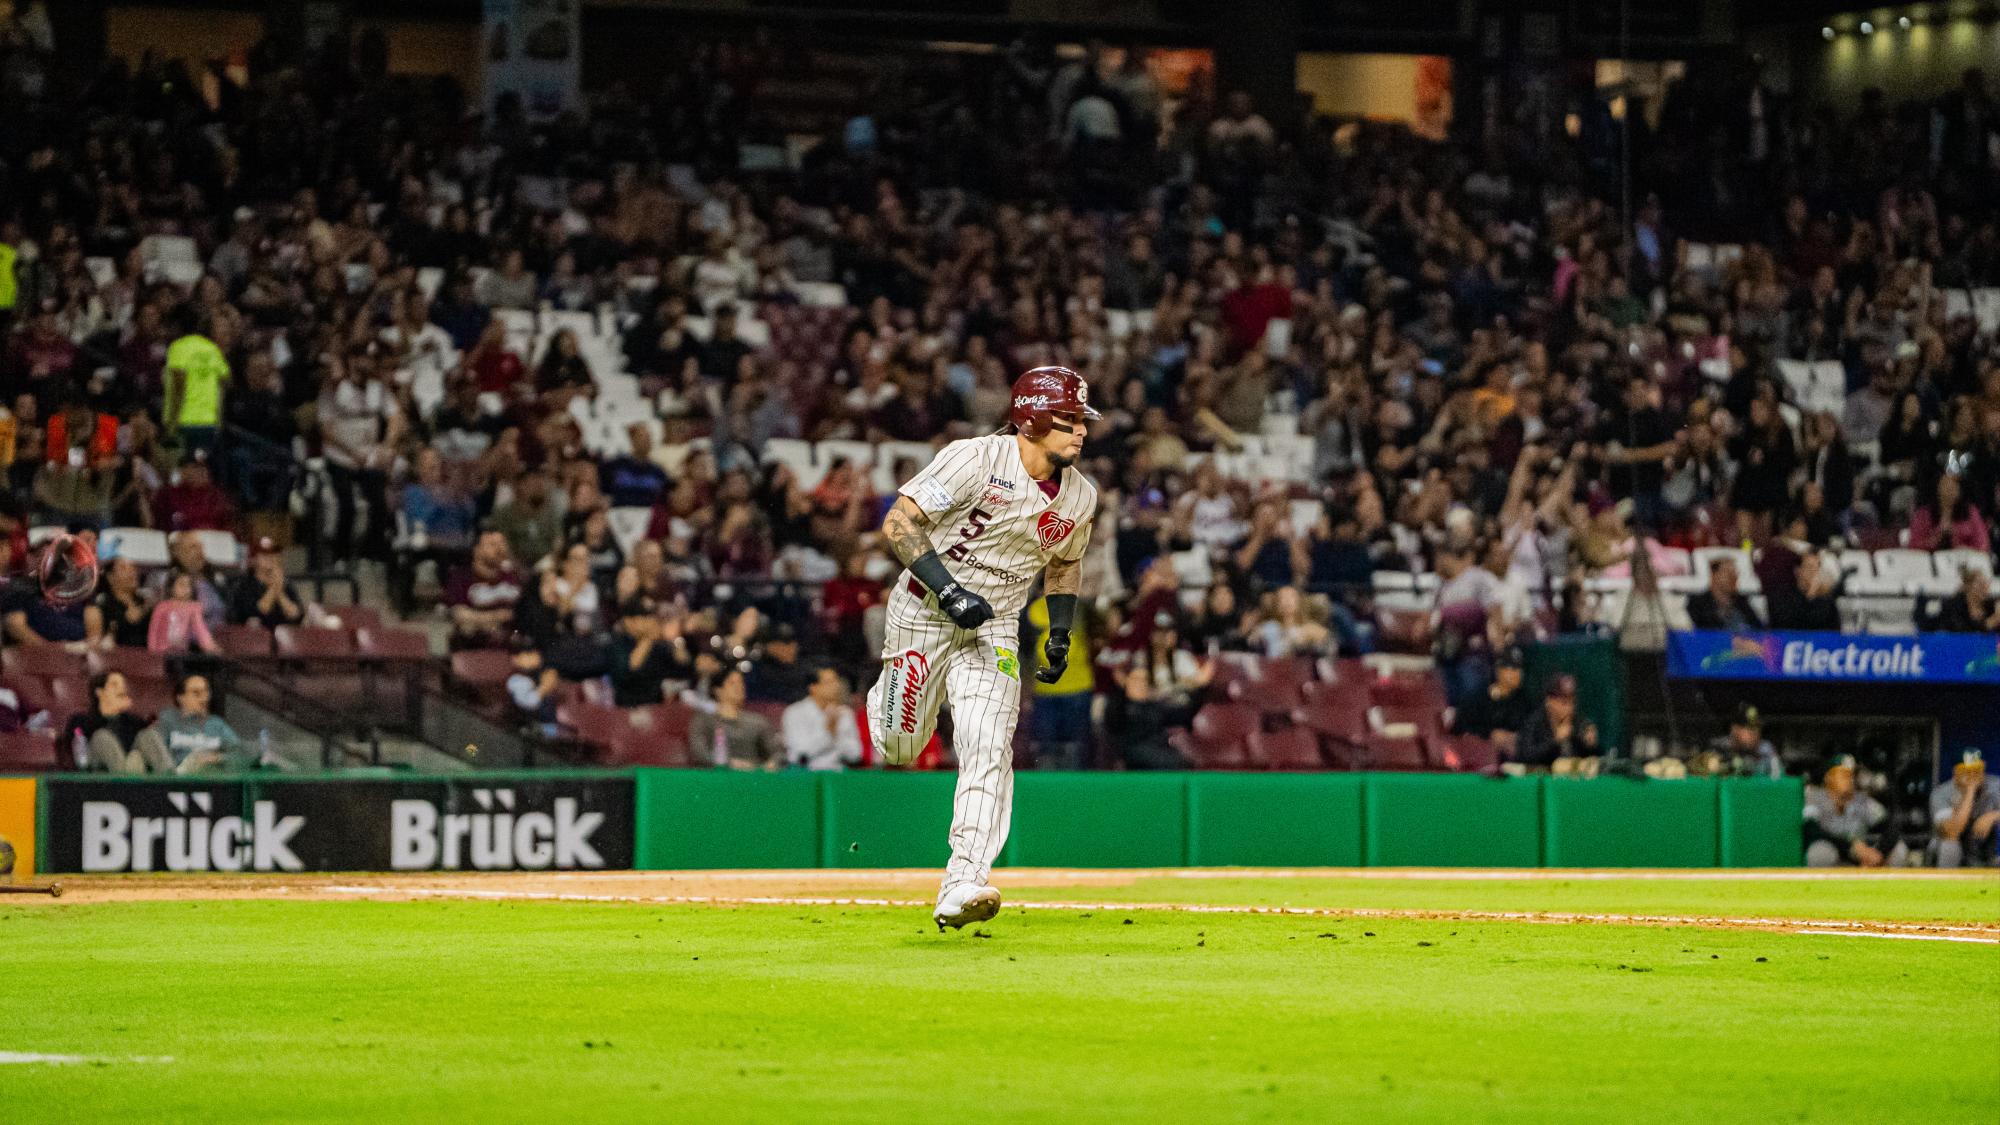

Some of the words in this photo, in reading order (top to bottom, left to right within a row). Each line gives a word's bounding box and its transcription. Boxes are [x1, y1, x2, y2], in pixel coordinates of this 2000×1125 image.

[960, 507, 992, 541] 5
[901, 650, 930, 733] Caliente
[1782, 641, 1925, 677] Electrolit
[886, 669, 899, 730] caliente.mx
[82, 792, 305, 872] Brück
[391, 789, 604, 870] Brück
